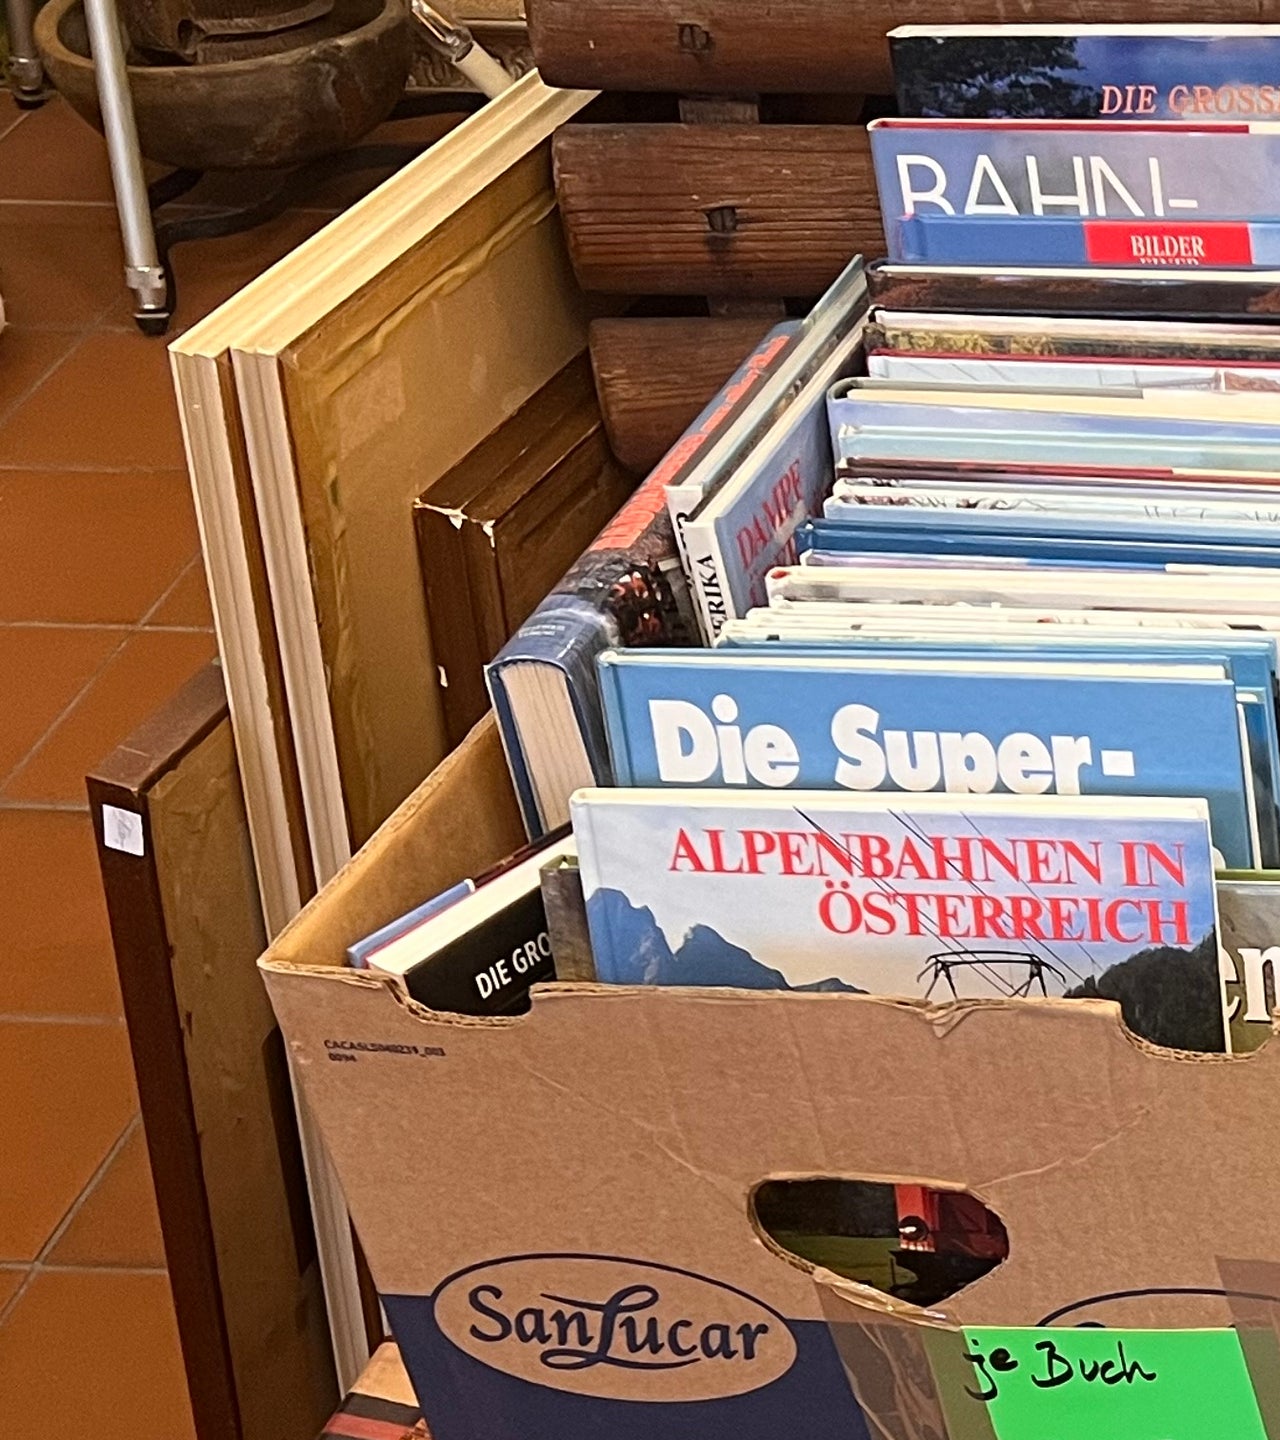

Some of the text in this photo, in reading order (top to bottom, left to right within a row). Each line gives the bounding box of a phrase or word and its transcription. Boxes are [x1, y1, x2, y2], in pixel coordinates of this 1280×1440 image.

[1101, 85, 1157, 114] DIE
[896, 154, 1198, 216] BAHN-
[1130, 235, 1205, 258] BILDER
[649, 694, 1135, 793] Die Super-
[669, 827, 1186, 888] ALPENBAHNEN IN
[818, 880, 1190, 945] ÖSTERREICH
[475, 959, 512, 999] DIE
[964, 1338, 1156, 1400] je Buch
